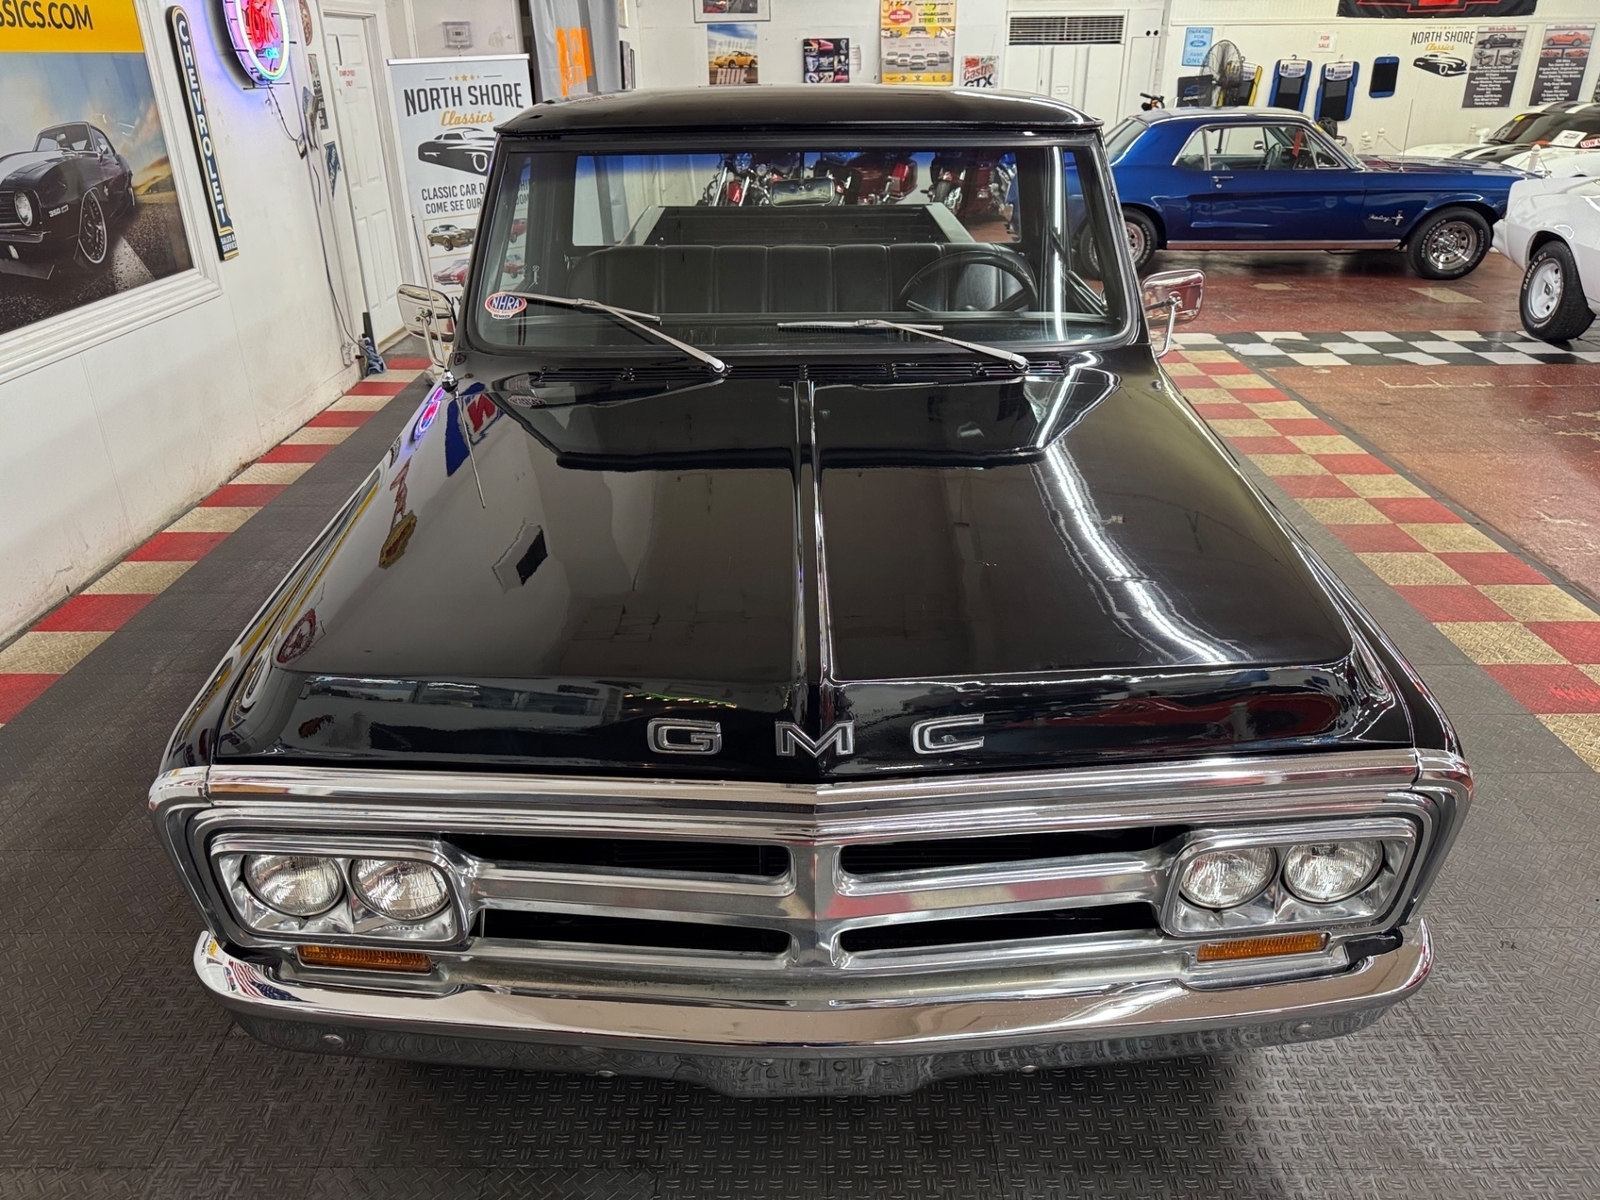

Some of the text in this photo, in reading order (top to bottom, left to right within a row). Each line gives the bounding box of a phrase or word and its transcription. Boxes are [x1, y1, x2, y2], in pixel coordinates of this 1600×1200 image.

[1410, 31, 1475, 45] NORTH SHORE
[716, 68, 748, 84] RIDE
[404, 82, 524, 117] NORTH SHORE
[178, 20, 227, 223] CHEVROLET
[440, 110, 495, 126] Classics
[421, 183, 458, 201] CLASSIC
[460, 182, 478, 197] CAR
[425, 198, 482, 215] COME SEE OUR
[1523, 260, 1539, 290] RADIAL
[492, 296, 520, 310] NHRA
[647, 713, 985, 758] GMC
